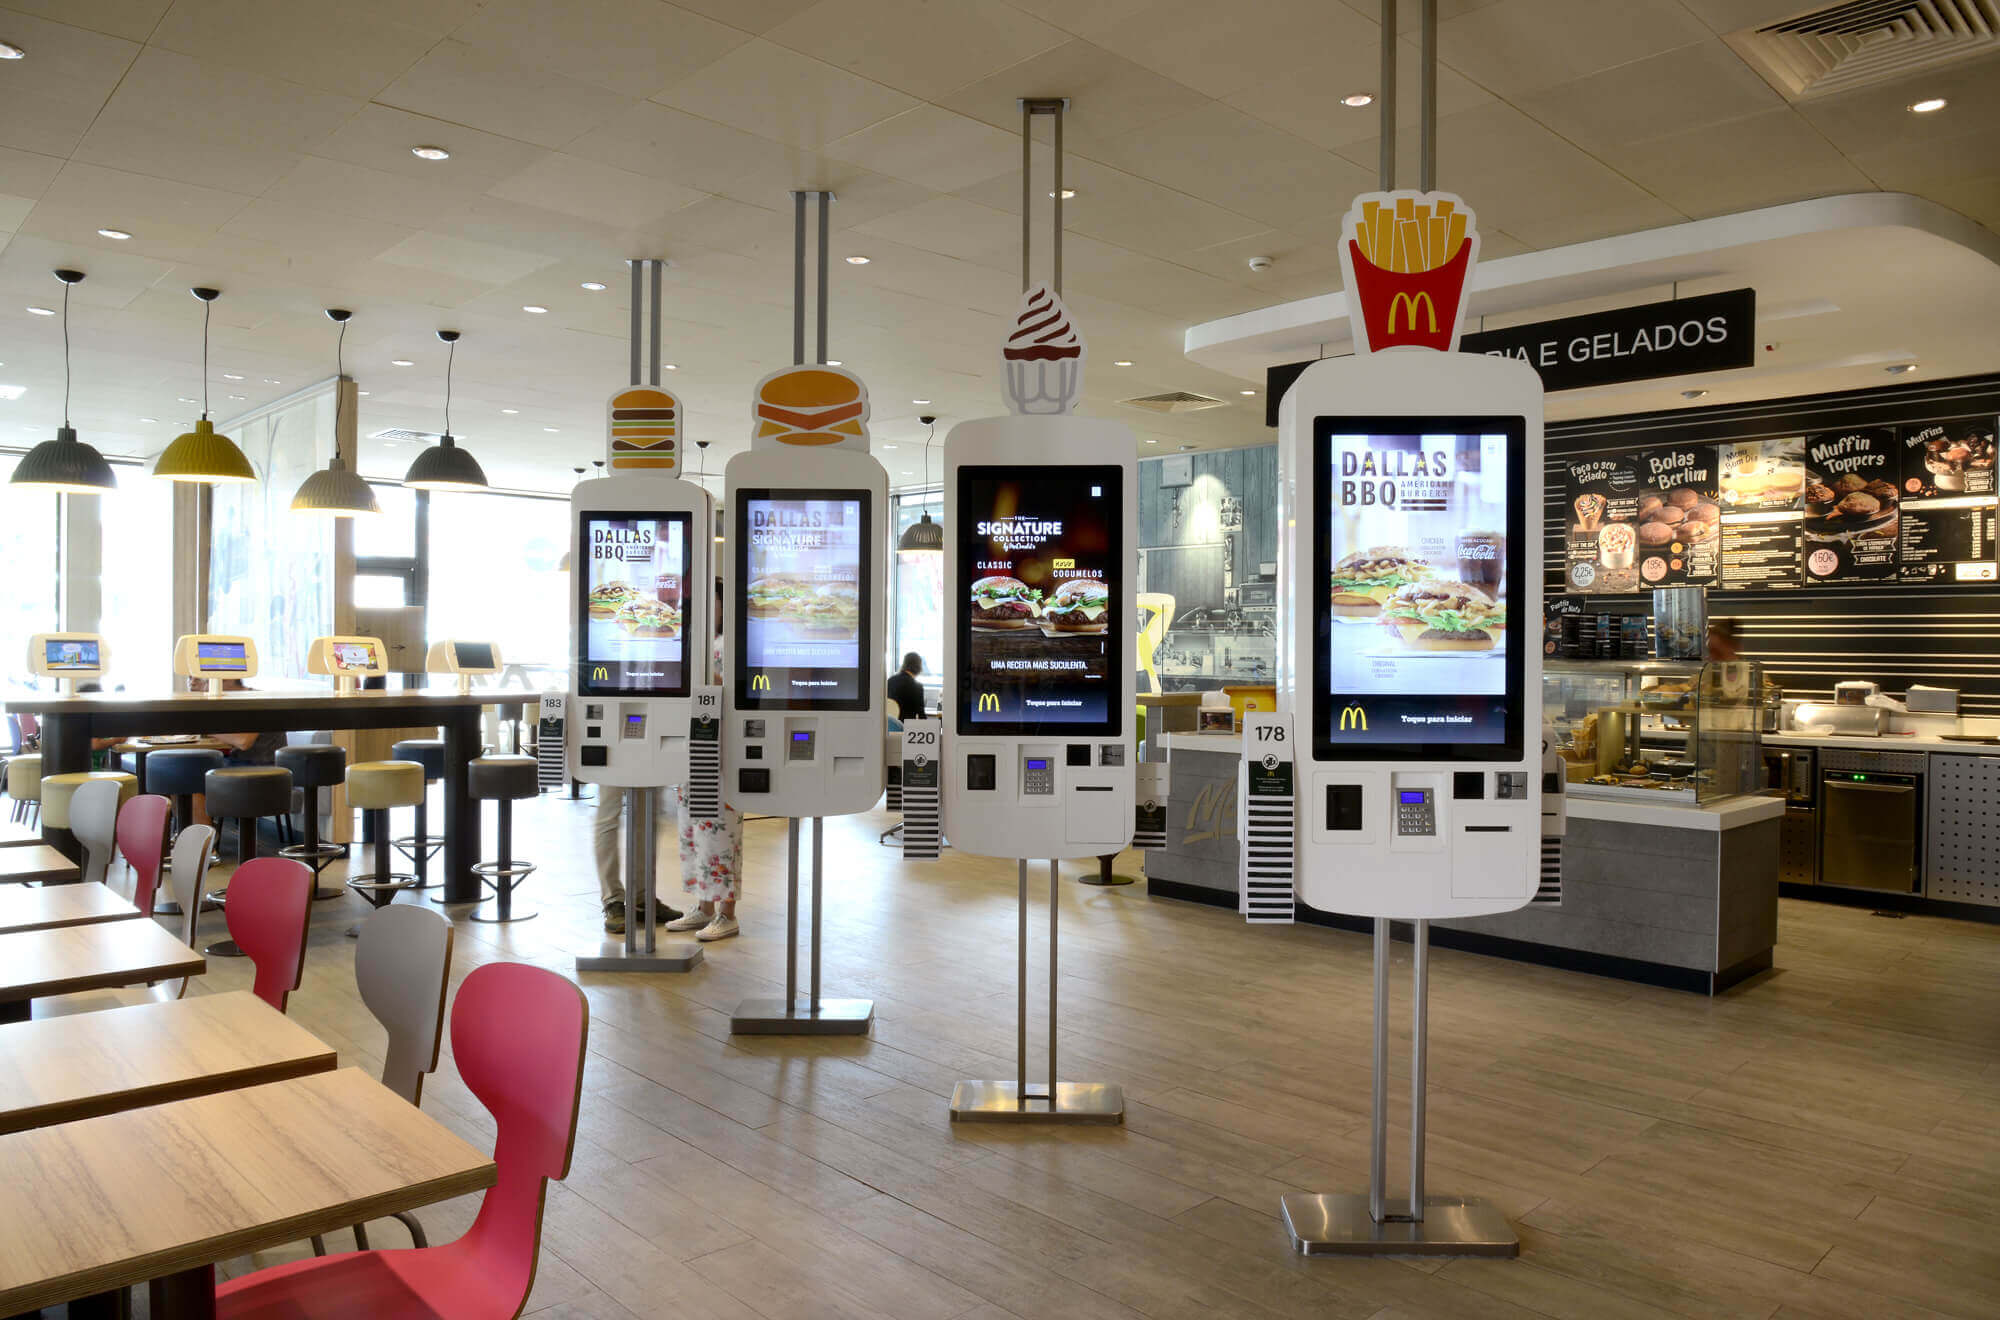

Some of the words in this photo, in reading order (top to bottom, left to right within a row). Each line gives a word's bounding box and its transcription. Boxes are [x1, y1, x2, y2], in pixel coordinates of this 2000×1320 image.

[1541, 341, 1558, 367] E
[1568, 317, 1728, 362] GELADOS
[1905, 426, 1944, 449] Muffins
[1811, 435, 1871, 463] Muffin
[1342, 451, 1447, 477] DALLAS
[1570, 463, 1591, 478] Faça
[1593, 461, 1599, 470] o
[1601, 461, 1617, 470] seu
[1649, 451, 1695, 474] Bolas
[1823, 454, 1885, 474] Toppers
[1578, 470, 1608, 485] Gelado
[1657, 467, 1708, 490] Berlim
[1342, 481, 1397, 511] BBQ
[754, 510, 822, 527] DALLAS
[977, 521, 1062, 535] SIGNATURE
[595, 529, 652, 544] DALLAS
[992, 535, 1047, 543] COLLECTION
[594, 545, 624, 562] BBQ
[977, 561, 1012, 569] CLASSIC
[1053, 570, 1103, 578] COGUMELOS
[991, 661, 1006, 669] UMA
[1006, 661, 1032, 669] RECEITA
[1033, 661, 1049, 669] MAIS
[1049, 661, 1088, 669] SUCULENTA.
[544, 699, 562, 708] 183
[698, 695, 716, 705] 181
[1026, 699, 1046, 707] Toque
[1400, 715, 1426, 724] Toque
[1427, 717, 1445, 725] para
[1446, 715, 1473, 723] iniciar
[907, 731, 936, 745] 220
[1255, 726, 1285, 742] 178
